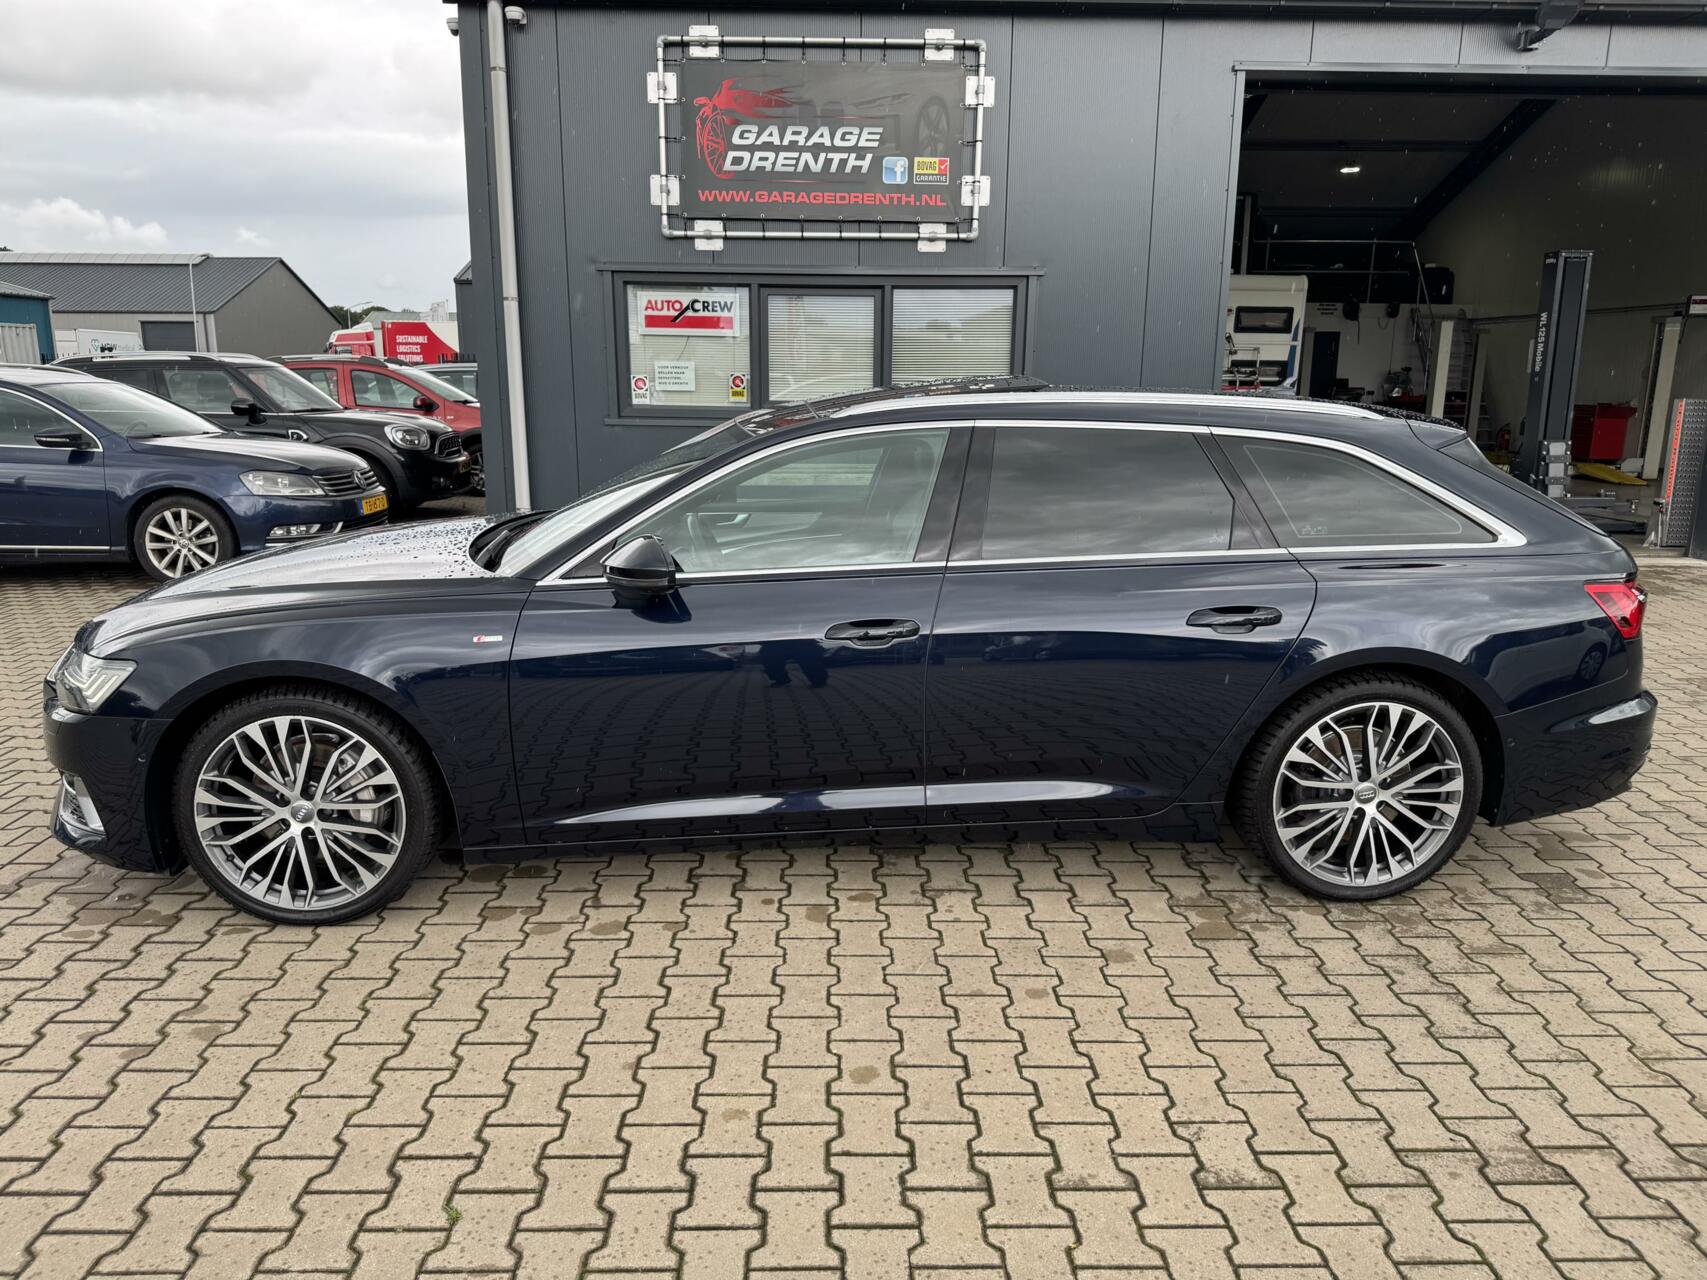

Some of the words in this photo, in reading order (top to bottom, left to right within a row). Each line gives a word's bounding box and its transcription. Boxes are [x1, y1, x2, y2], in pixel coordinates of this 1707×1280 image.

[731, 124, 884, 148] GARAGE
[723, 150, 873, 174] DRENTH
[916, 160, 937, 171] BOVAG
[698, 189, 947, 207] WWW.GARAGEDRENTH.NL
[644, 299, 684, 312] AUTO
[690, 299, 734, 313] CREW
[396, 335, 428, 343] SUSTAINABLE
[396, 344, 421, 352] LOGISTICS
[1535, 342, 1544, 372] Mobile
